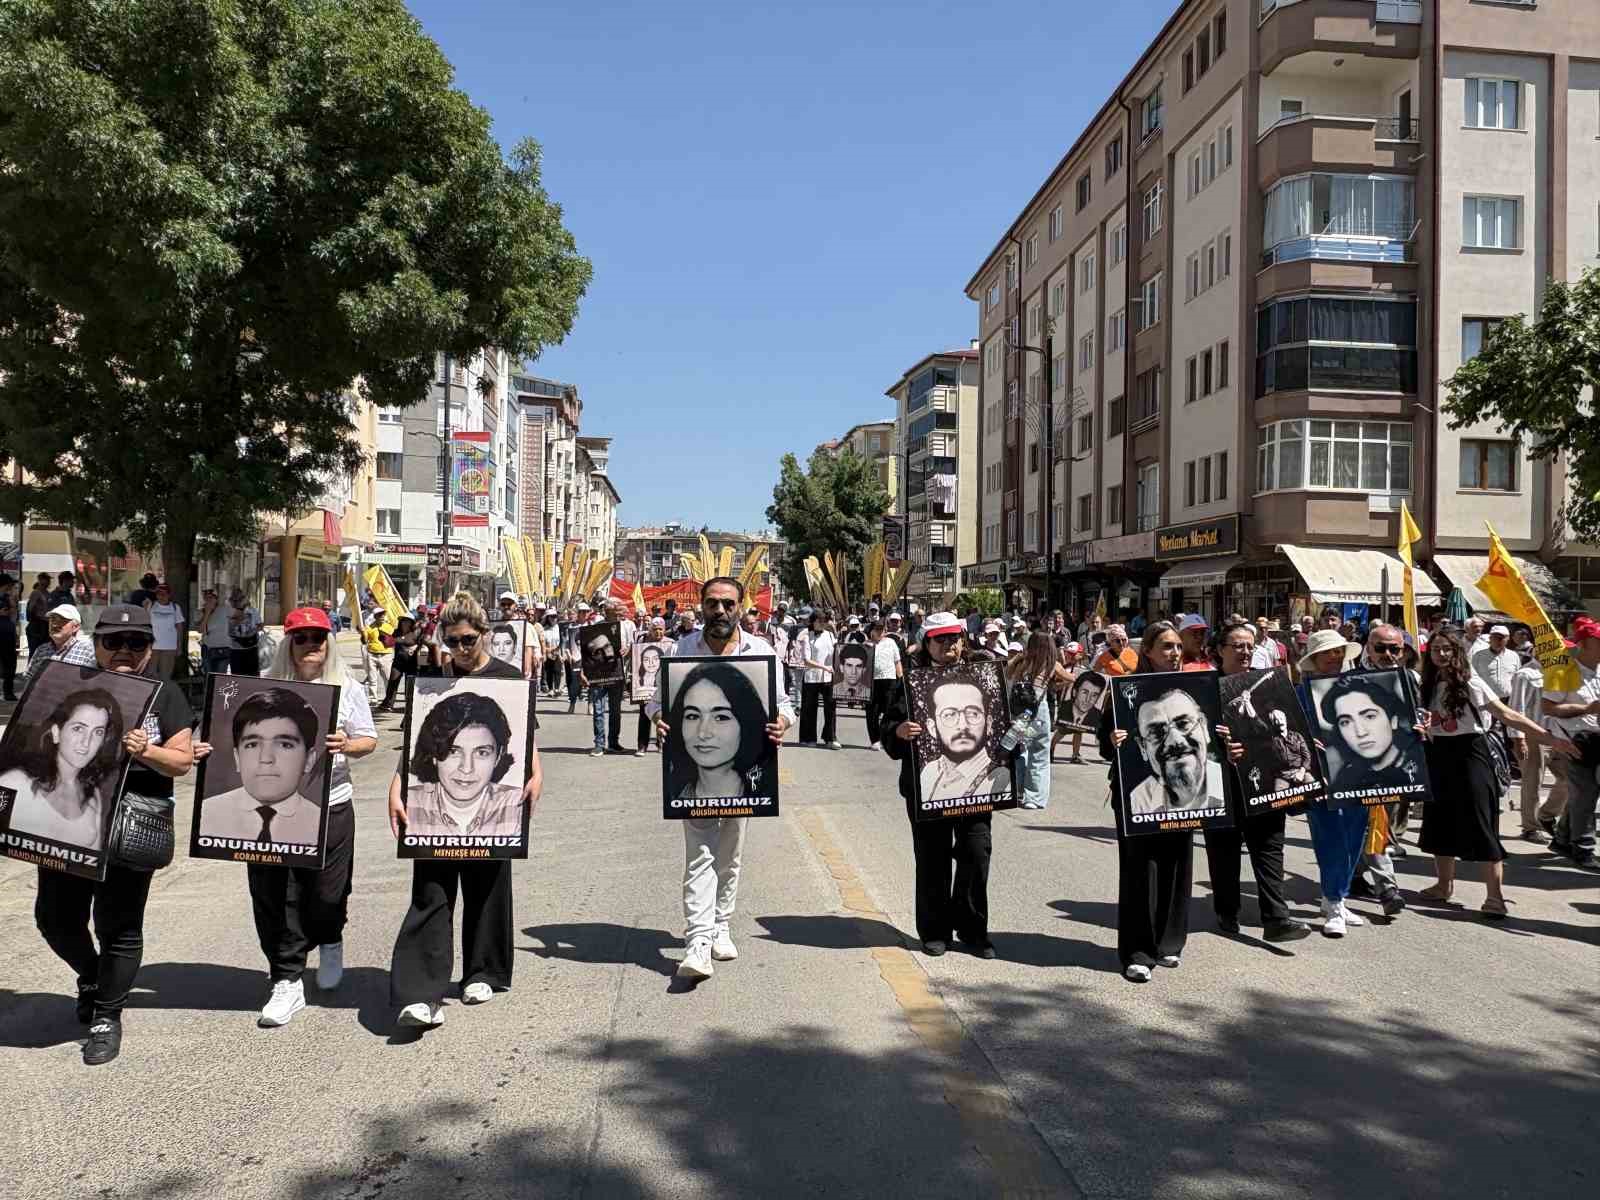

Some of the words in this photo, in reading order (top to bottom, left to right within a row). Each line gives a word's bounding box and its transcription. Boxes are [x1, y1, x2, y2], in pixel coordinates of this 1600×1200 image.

[1191, 528, 1217, 546] Market
[1250, 781, 1321, 806] ONURUMUZ
[1333, 784, 1425, 799] ONURUMUZ
[670, 797, 772, 809] ONURUMUZ
[922, 792, 1013, 811] ONURUMUZ
[1132, 808, 1226, 824] ONURUMUZ
[198, 837, 318, 856] ONURUMUZ
[404, 836, 521, 847] ONURUMUZ
[233, 852, 260, 862] KORAY
[261, 854, 282, 863] KAYA
[469, 848, 490, 857] KAYA
